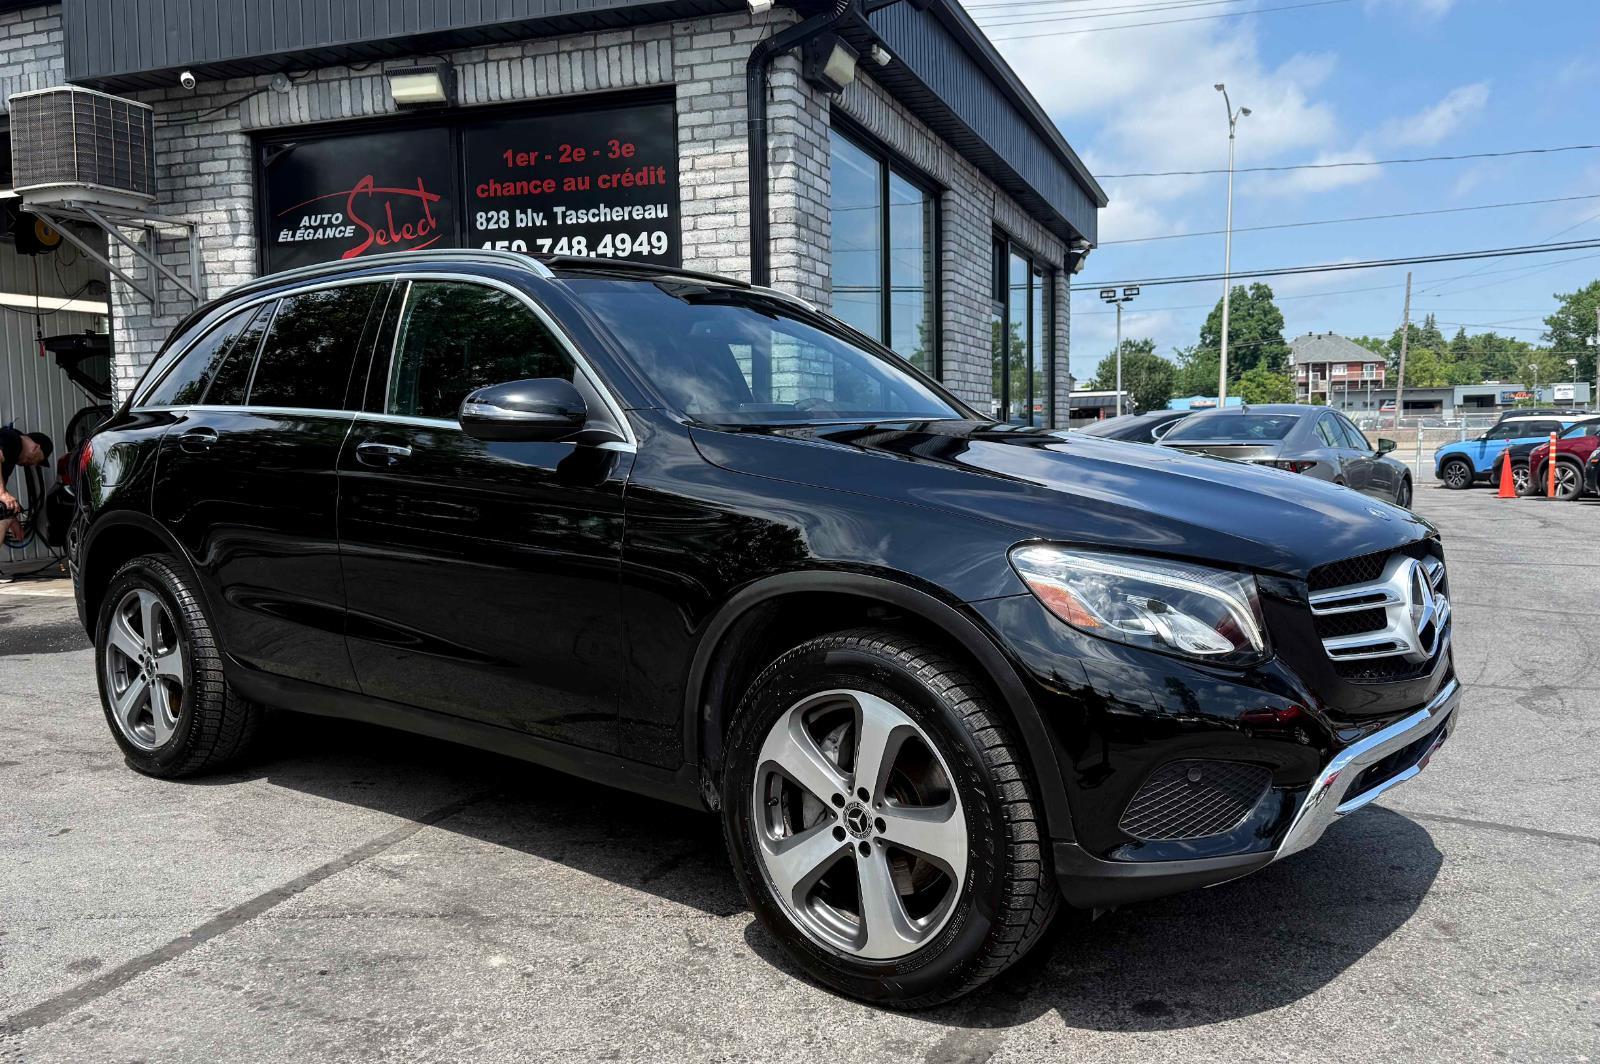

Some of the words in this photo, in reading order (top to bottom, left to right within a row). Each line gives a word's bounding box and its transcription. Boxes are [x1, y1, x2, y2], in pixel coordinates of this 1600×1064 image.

[503, 148, 539, 168] 1er
[558, 143, 586, 164] 2e
[607, 139, 635, 159] 3e
[475, 178, 556, 198] chance
[563, 174, 590, 193] au
[597, 164, 667, 189] crédit
[299, 212, 344, 228] AUTO
[475, 209, 511, 231] 828
[515, 207, 548, 229] blv.
[552, 202, 669, 226] Taschereau
[277, 225, 356, 243] ÉLÉGANCE
[481, 230, 669, 259] 748.4949
